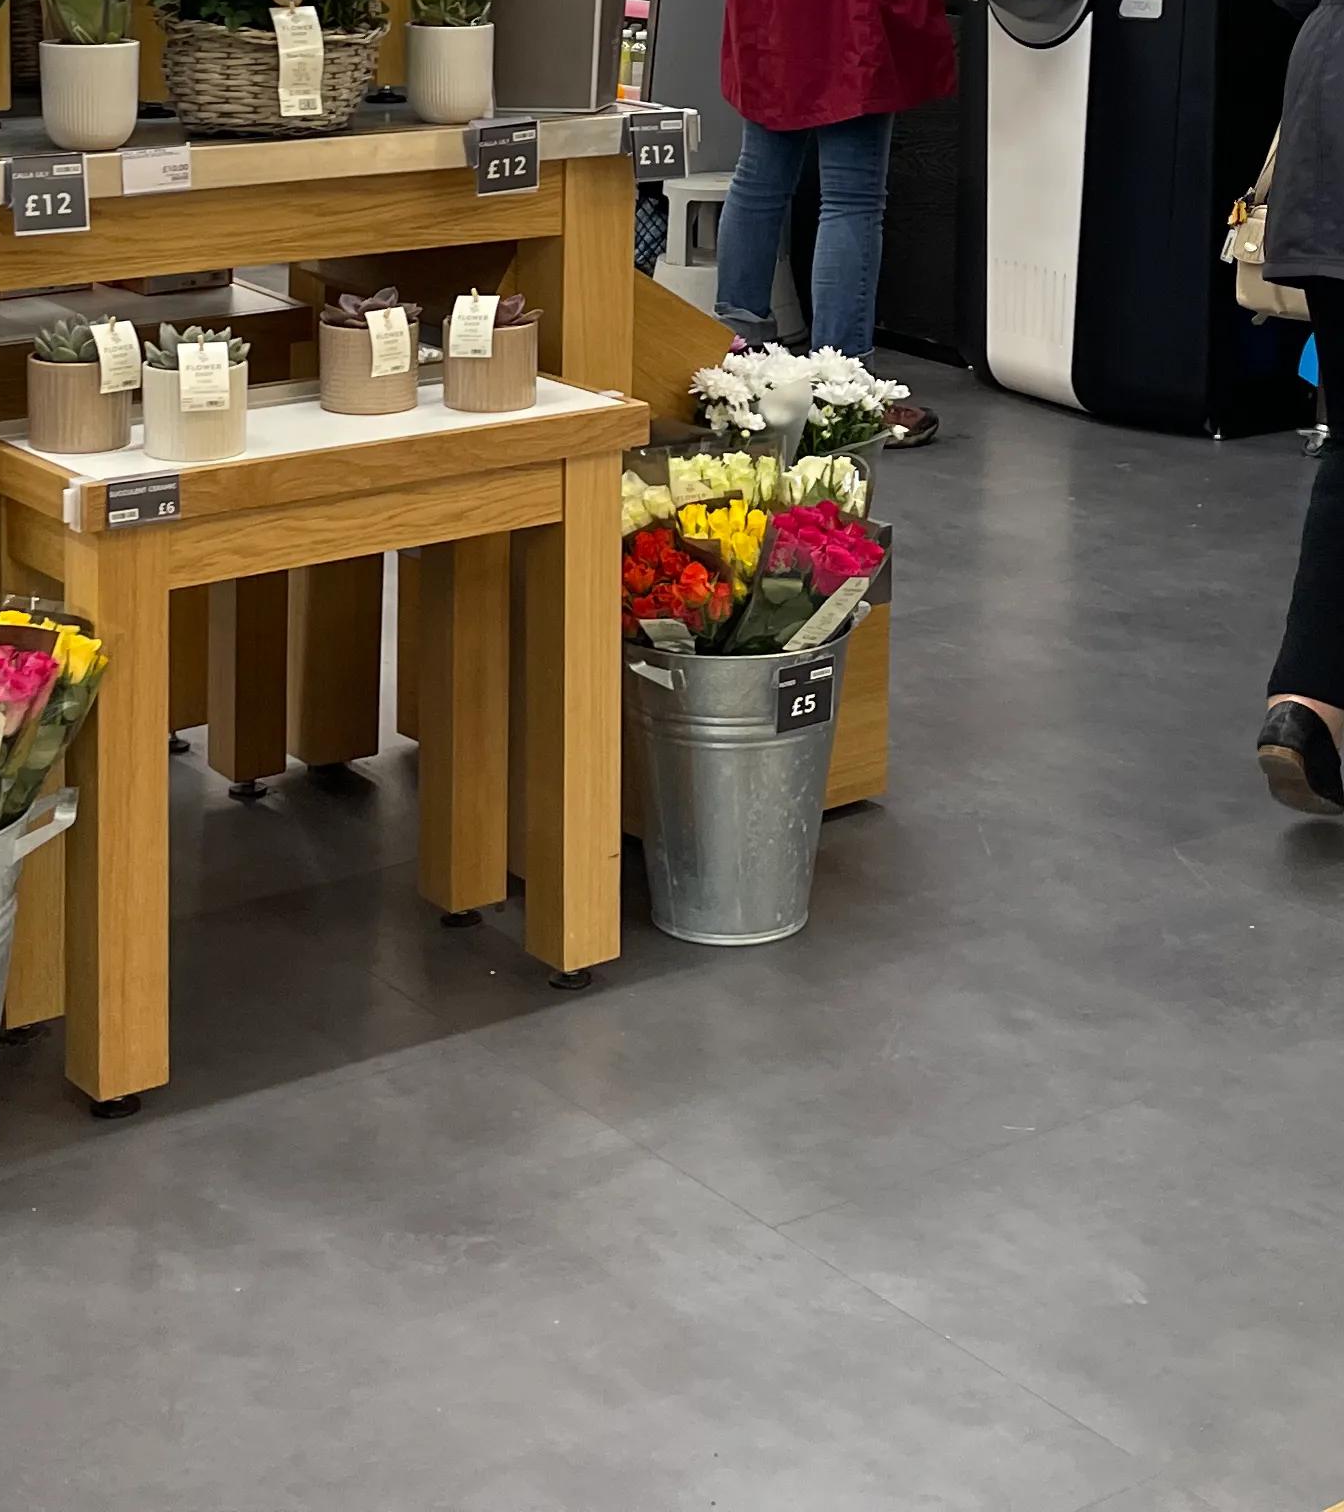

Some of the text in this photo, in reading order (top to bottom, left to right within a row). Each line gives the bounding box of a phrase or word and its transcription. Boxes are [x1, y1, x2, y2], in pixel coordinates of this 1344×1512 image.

[639, 144, 675, 165] £12
[486, 156, 526, 179] £12
[25, 193, 72, 217] £12
[185, 363, 222, 371] FLOWER
[109, 487, 147, 498] SUCCULENT
[158, 501, 176, 515] £6
[791, 693, 816, 716] £5
